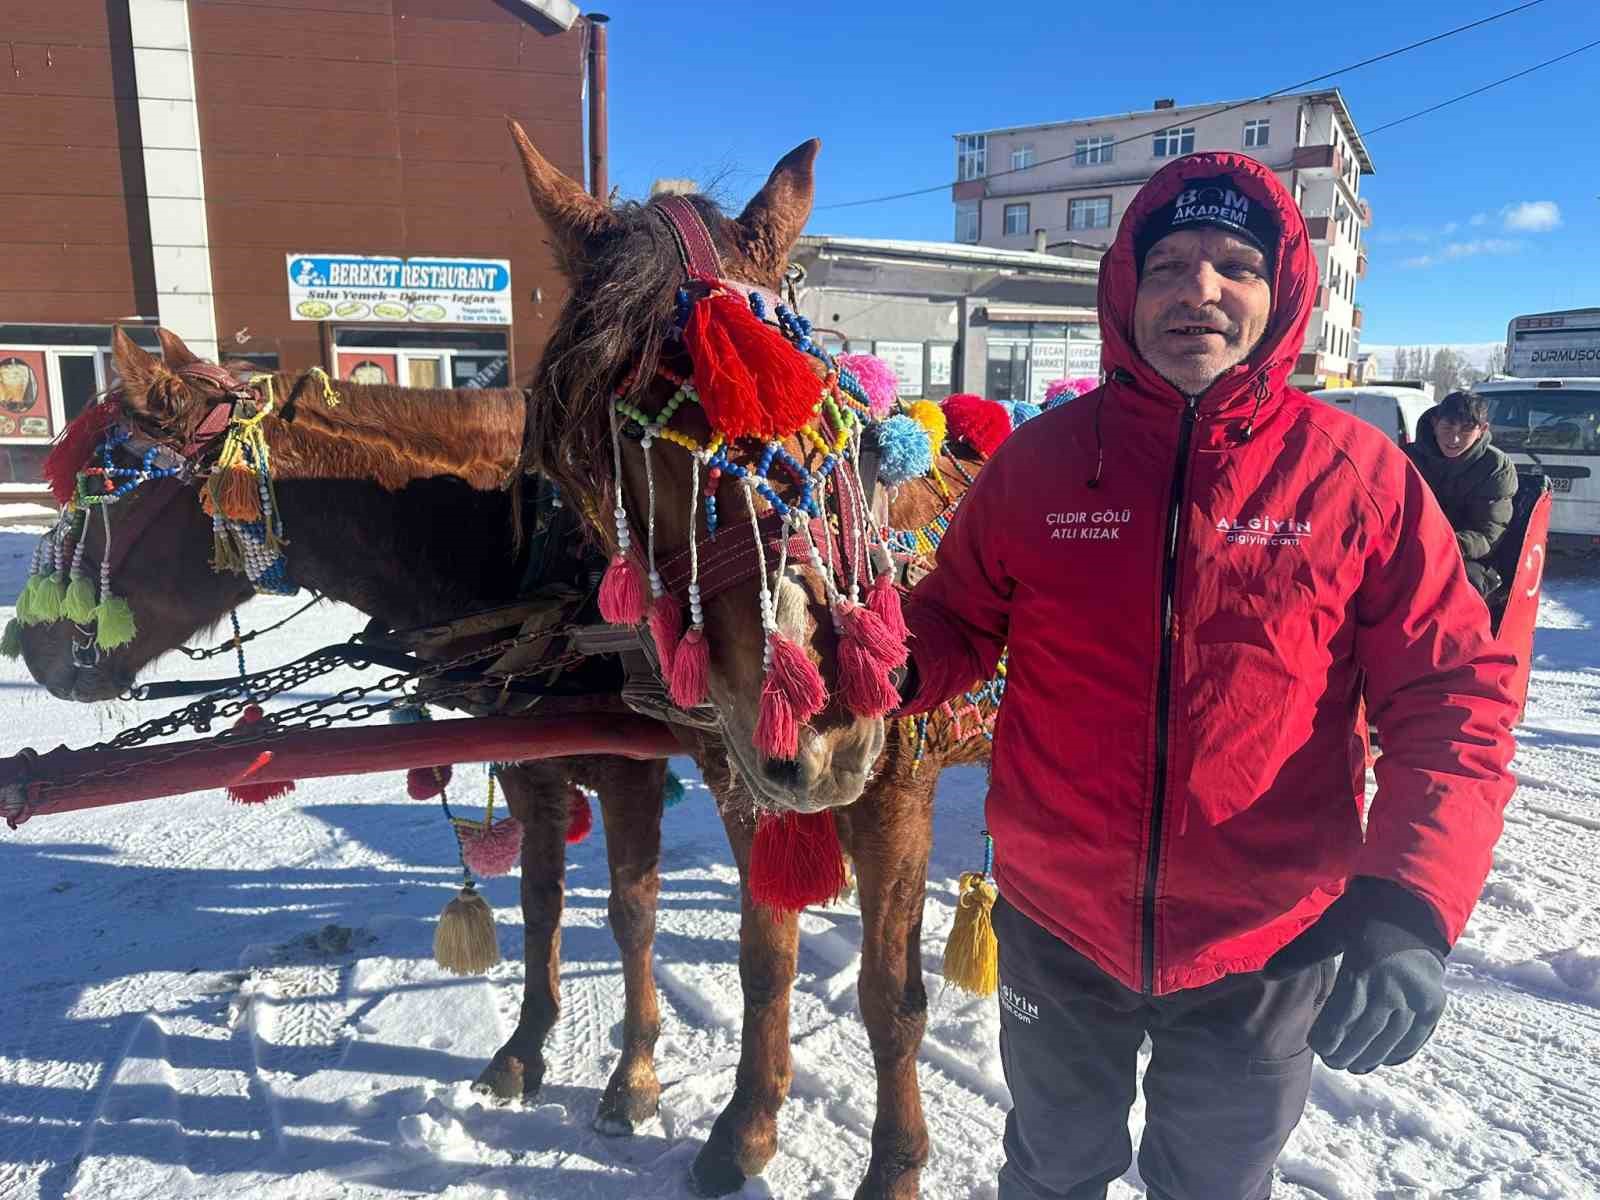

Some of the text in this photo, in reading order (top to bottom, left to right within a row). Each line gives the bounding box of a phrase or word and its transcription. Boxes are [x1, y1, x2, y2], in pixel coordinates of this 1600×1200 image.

[330, 263, 498, 289] BEREKET RESTAURANT
[307, 290, 338, 300] Sulu
[342, 290, 386, 300] Yemek
[1033, 359, 1064, 368] MARKET
[1046, 509, 1131, 525] ÇILDIR GÖLÜ
[1050, 528, 1119, 539] ATLI KIZAK
